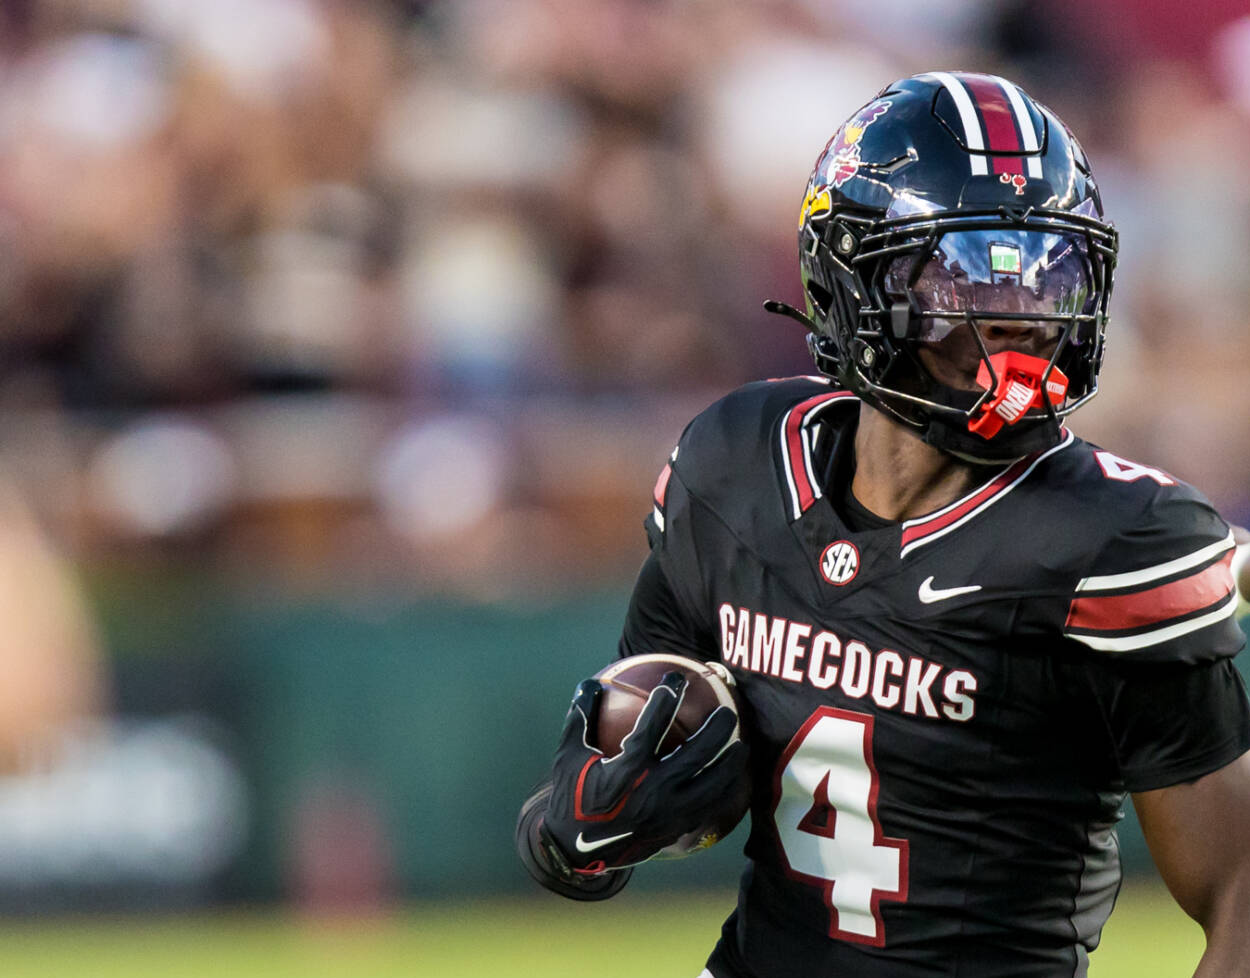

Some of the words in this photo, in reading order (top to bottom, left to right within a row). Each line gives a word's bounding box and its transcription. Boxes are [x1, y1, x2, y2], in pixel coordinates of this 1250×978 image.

[1092, 449, 1178, 486] 4
[822, 542, 858, 583] SEC
[719, 602, 977, 722] GAMECOCKS
[774, 704, 910, 948] 4
